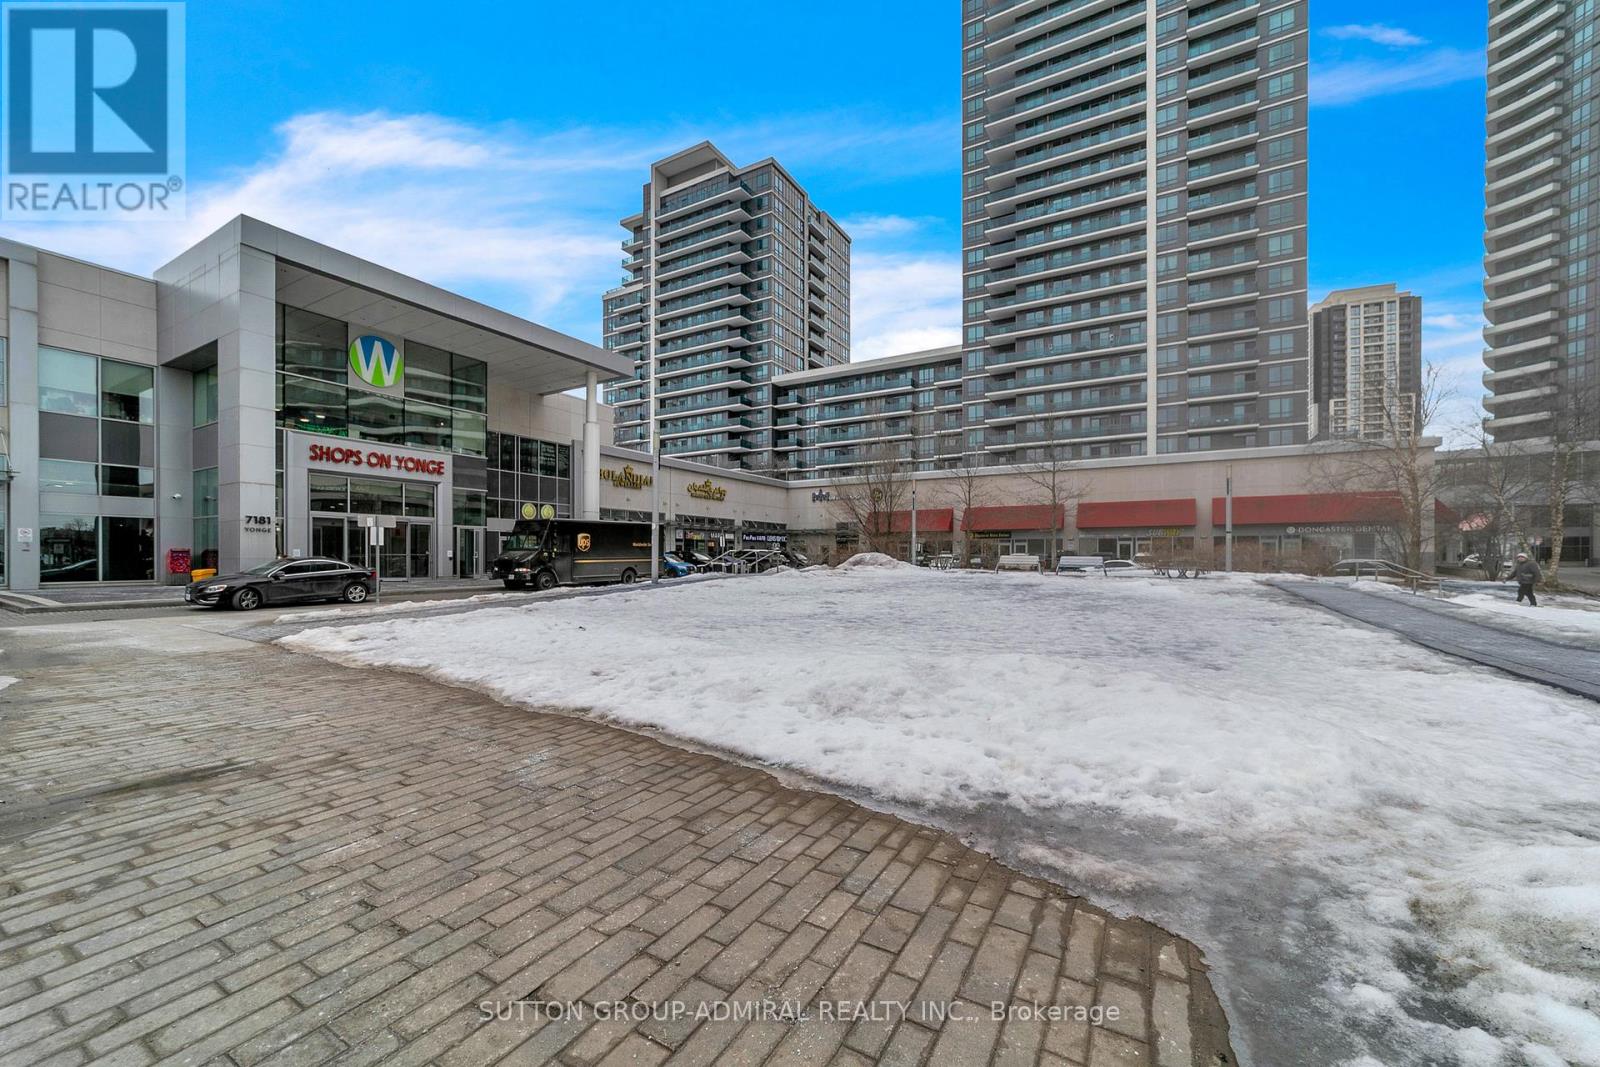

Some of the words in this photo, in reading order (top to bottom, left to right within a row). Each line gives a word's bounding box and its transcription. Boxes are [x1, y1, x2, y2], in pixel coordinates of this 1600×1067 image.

[309, 444, 362, 466] SHOPS
[366, 452, 391, 469] ON
[395, 455, 445, 475] YONGE
[245, 515, 271, 525] 7181
